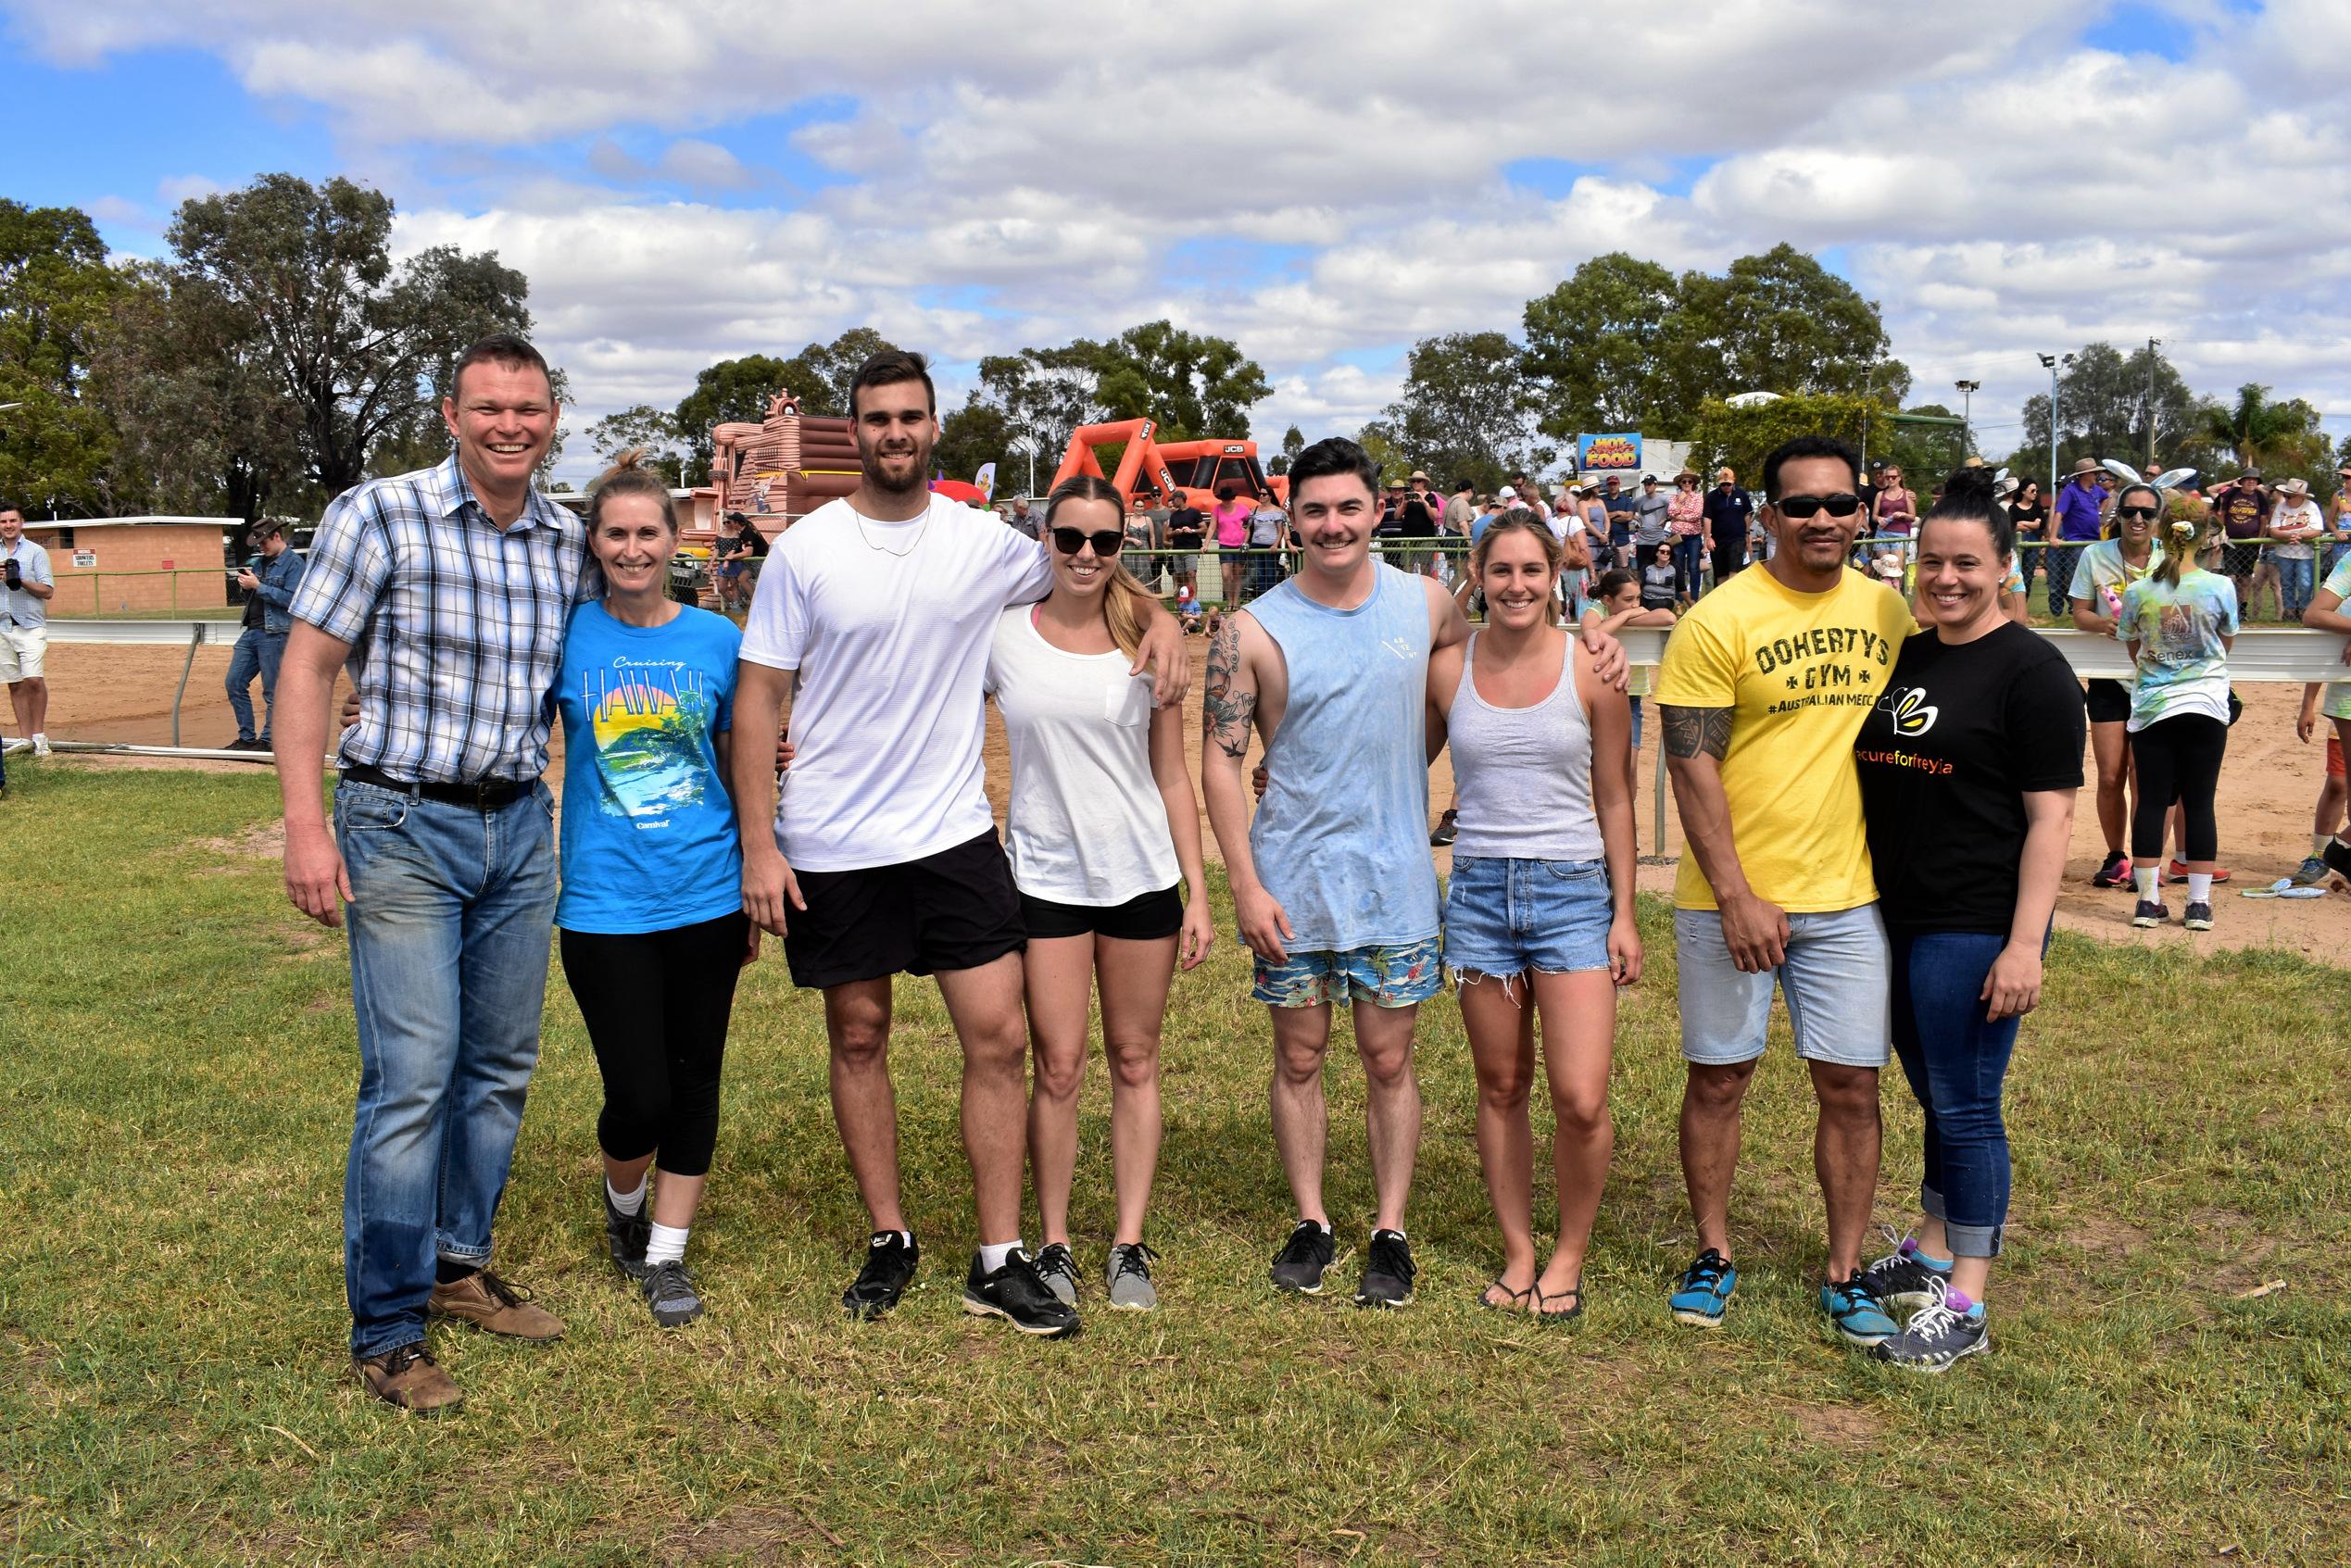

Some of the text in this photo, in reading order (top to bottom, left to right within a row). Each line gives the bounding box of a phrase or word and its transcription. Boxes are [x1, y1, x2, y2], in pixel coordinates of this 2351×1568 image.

[1586, 452, 1637, 468] FOOD
[1160, 469, 1176, 492] JCB
[1755, 627, 1890, 675] DOHERTYS
[2147, 650, 2194, 662] Senex
[613, 656, 687, 671] Cruising
[1804, 663, 1851, 689] GYM
[578, 668, 707, 722] HAWAII
[1847, 694, 1879, 707] MECC
[636, 819, 671, 830] Carnival
